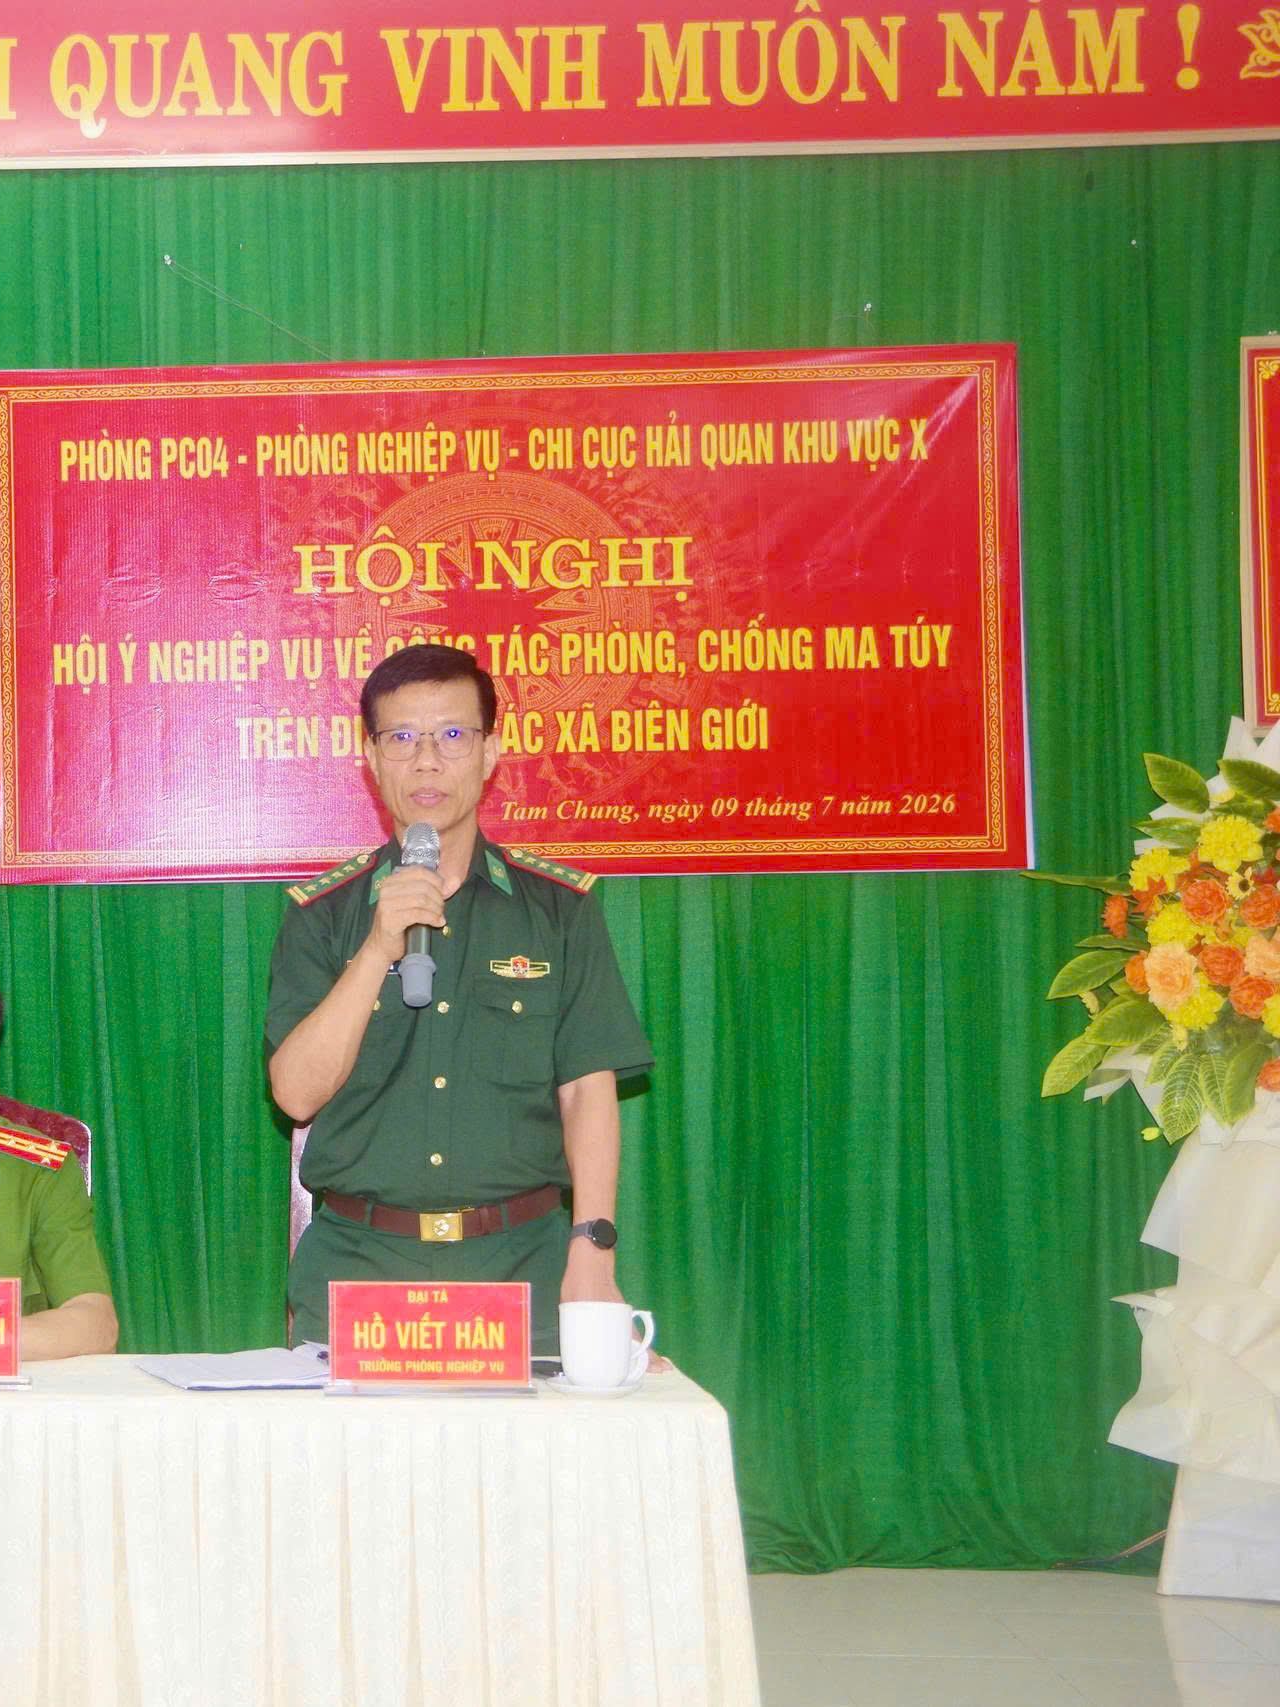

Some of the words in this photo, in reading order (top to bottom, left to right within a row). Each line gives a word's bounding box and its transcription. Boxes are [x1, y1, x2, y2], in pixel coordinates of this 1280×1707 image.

[49, 30, 348, 139] QUANG
[380, 25, 606, 114] VINH
[637, 0, 906, 106] MUÔN
[1176, 3, 1200, 90] !
[60, 429, 152, 482] PHÒNG
[161, 437, 229, 480] PC04
[256, 424, 349, 477] PHÒNG
[357, 422, 458, 482] NGHIỆP
[466, 430, 500, 481] VỤ
[528, 427, 573, 471] CHI
[582, 425, 636, 478] CỤC
[646, 410, 691, 468] HẢI
[701, 422, 774, 472] QUAN
[783, 420, 838, 464] KHU
[846, 414, 901, 472] VỰC
[909, 418, 929, 461] X
[292, 526, 447, 607] HỘI
[475, 535, 695, 602] NGHỊ
[53, 633, 107, 695] HỘI
[118, 632, 137, 684] Ý
[149, 630, 270, 691] NGHIỆP
[281, 637, 322, 689] VỤ
[333, 622, 373, 680] VỀ
[486, 625, 550, 677] TÁC
[560, 620, 686, 679] PHÒNG,
[697, 613, 813, 673] CHỐNG
[825, 625, 880, 670] MA
[889, 616, 953, 668] TÚY
[236, 708, 320, 760] TRÊN
[331, 715, 368, 766] ĐỊ
[495, 703, 544, 753] ÁC
[555, 702, 601, 753] XÃ
[611, 700, 691, 752] BIÊN
[701, 699, 769, 751] GIỚI
[501, 800, 548, 821] Tam
[556, 800, 640, 824] Chung,
[648, 798, 704, 823] ngày
[711, 797, 739, 817] 09
[745, 794, 812, 821] tháng
[821, 796, 834, 816] 7
[840, 795, 891, 815] năm
[899, 793, 956, 815] 2026
[353, 1312, 386, 1349] HỒ
[395, 1312, 446, 1349] VIẾT
